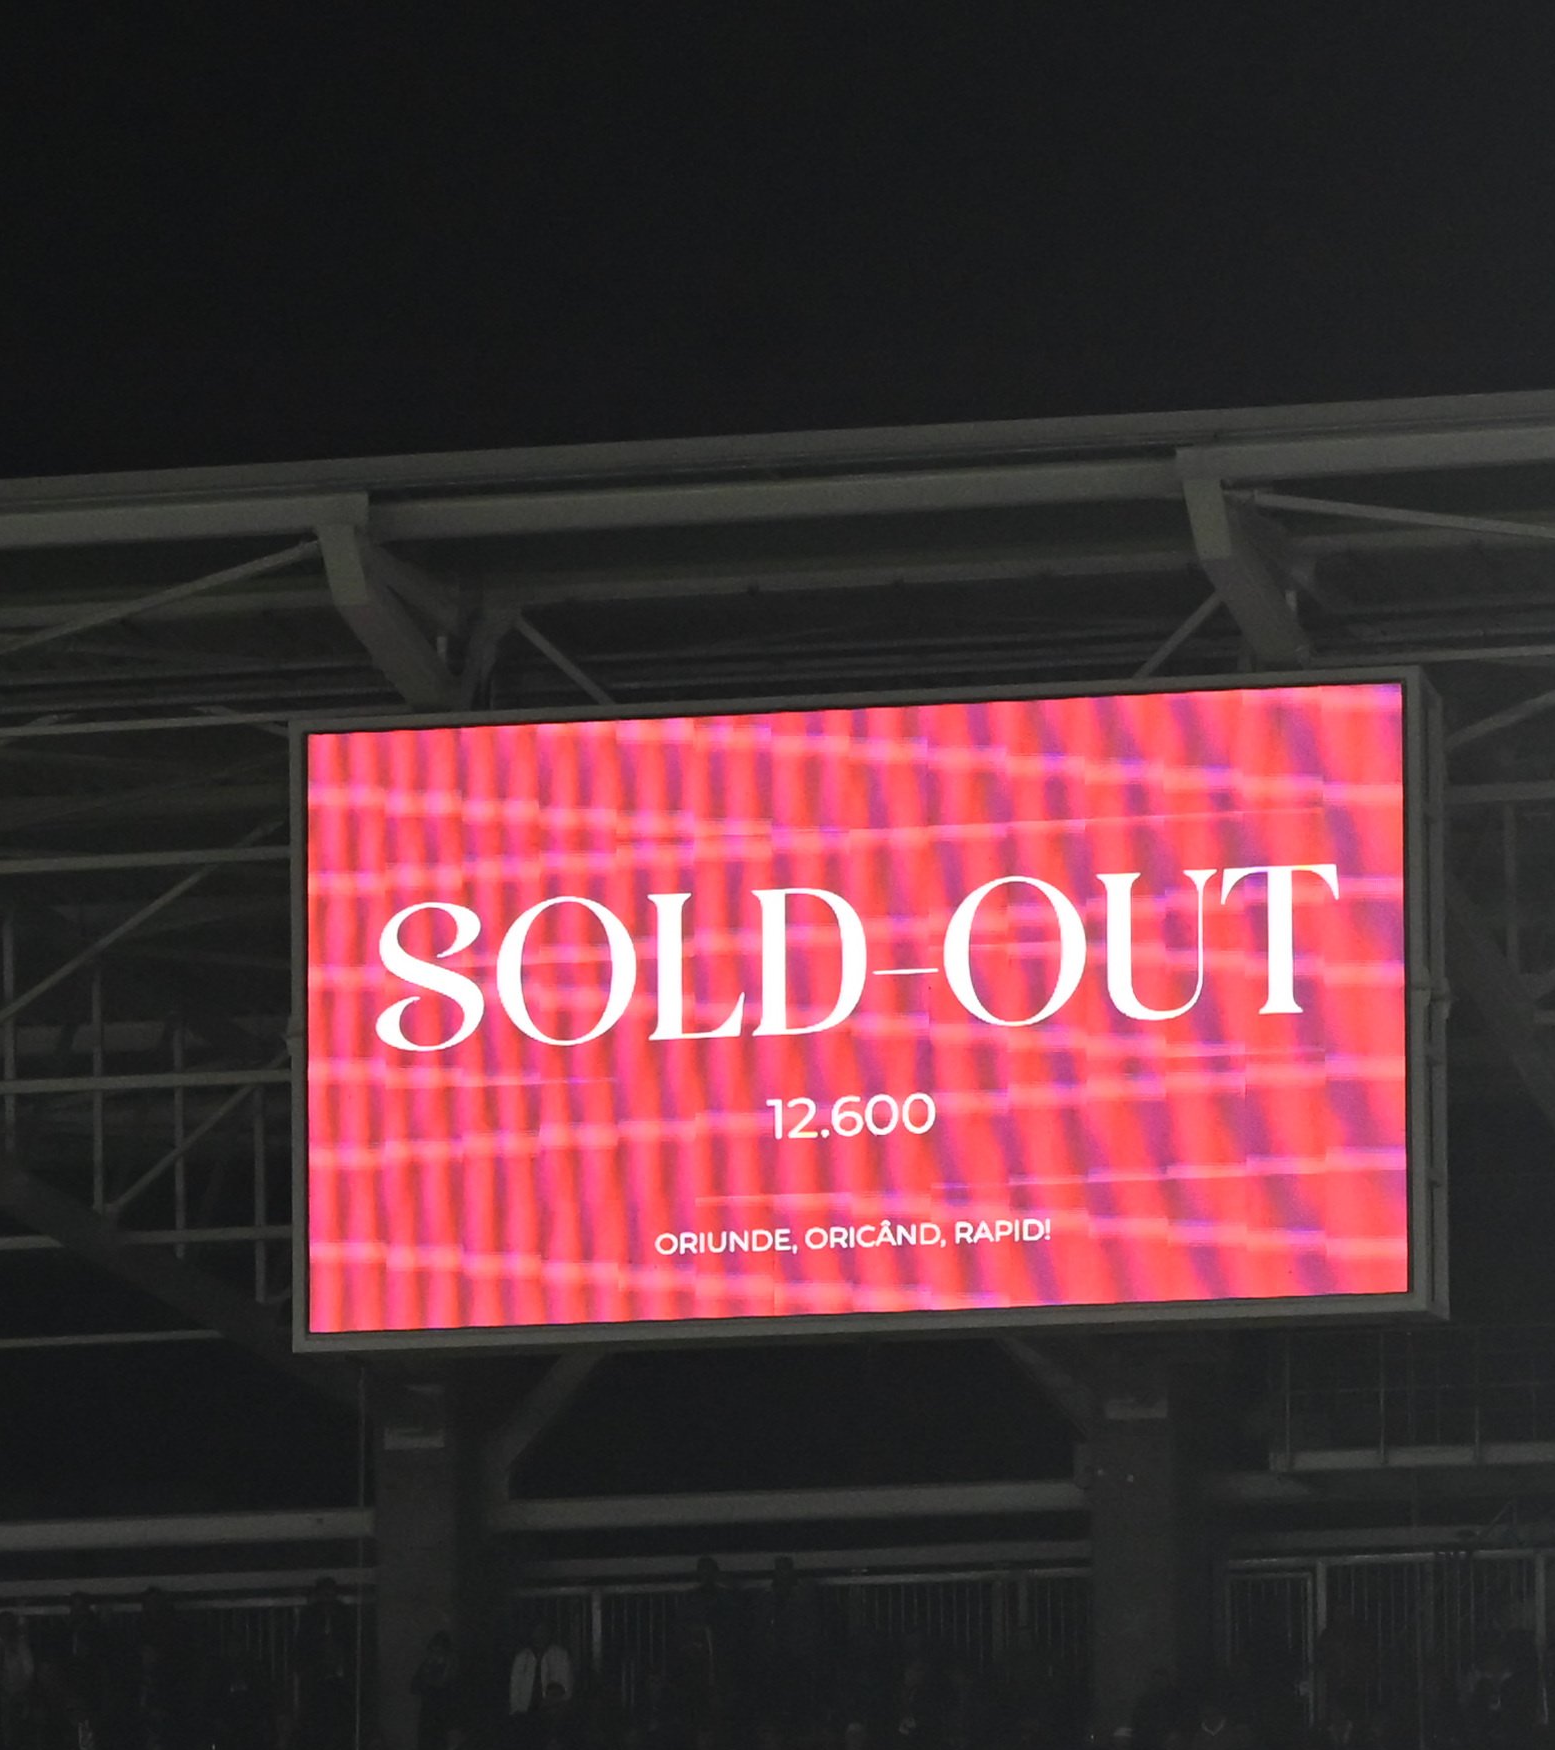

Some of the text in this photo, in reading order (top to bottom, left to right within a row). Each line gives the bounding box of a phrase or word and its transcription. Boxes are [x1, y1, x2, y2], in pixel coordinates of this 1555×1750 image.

[374, 862, 1339, 1052] SOLD-OUT
[765, 1092, 937, 1141] 12.600
[654, 1218, 1052, 1257] ORIUNDE, ORICÂND, RAPID!
